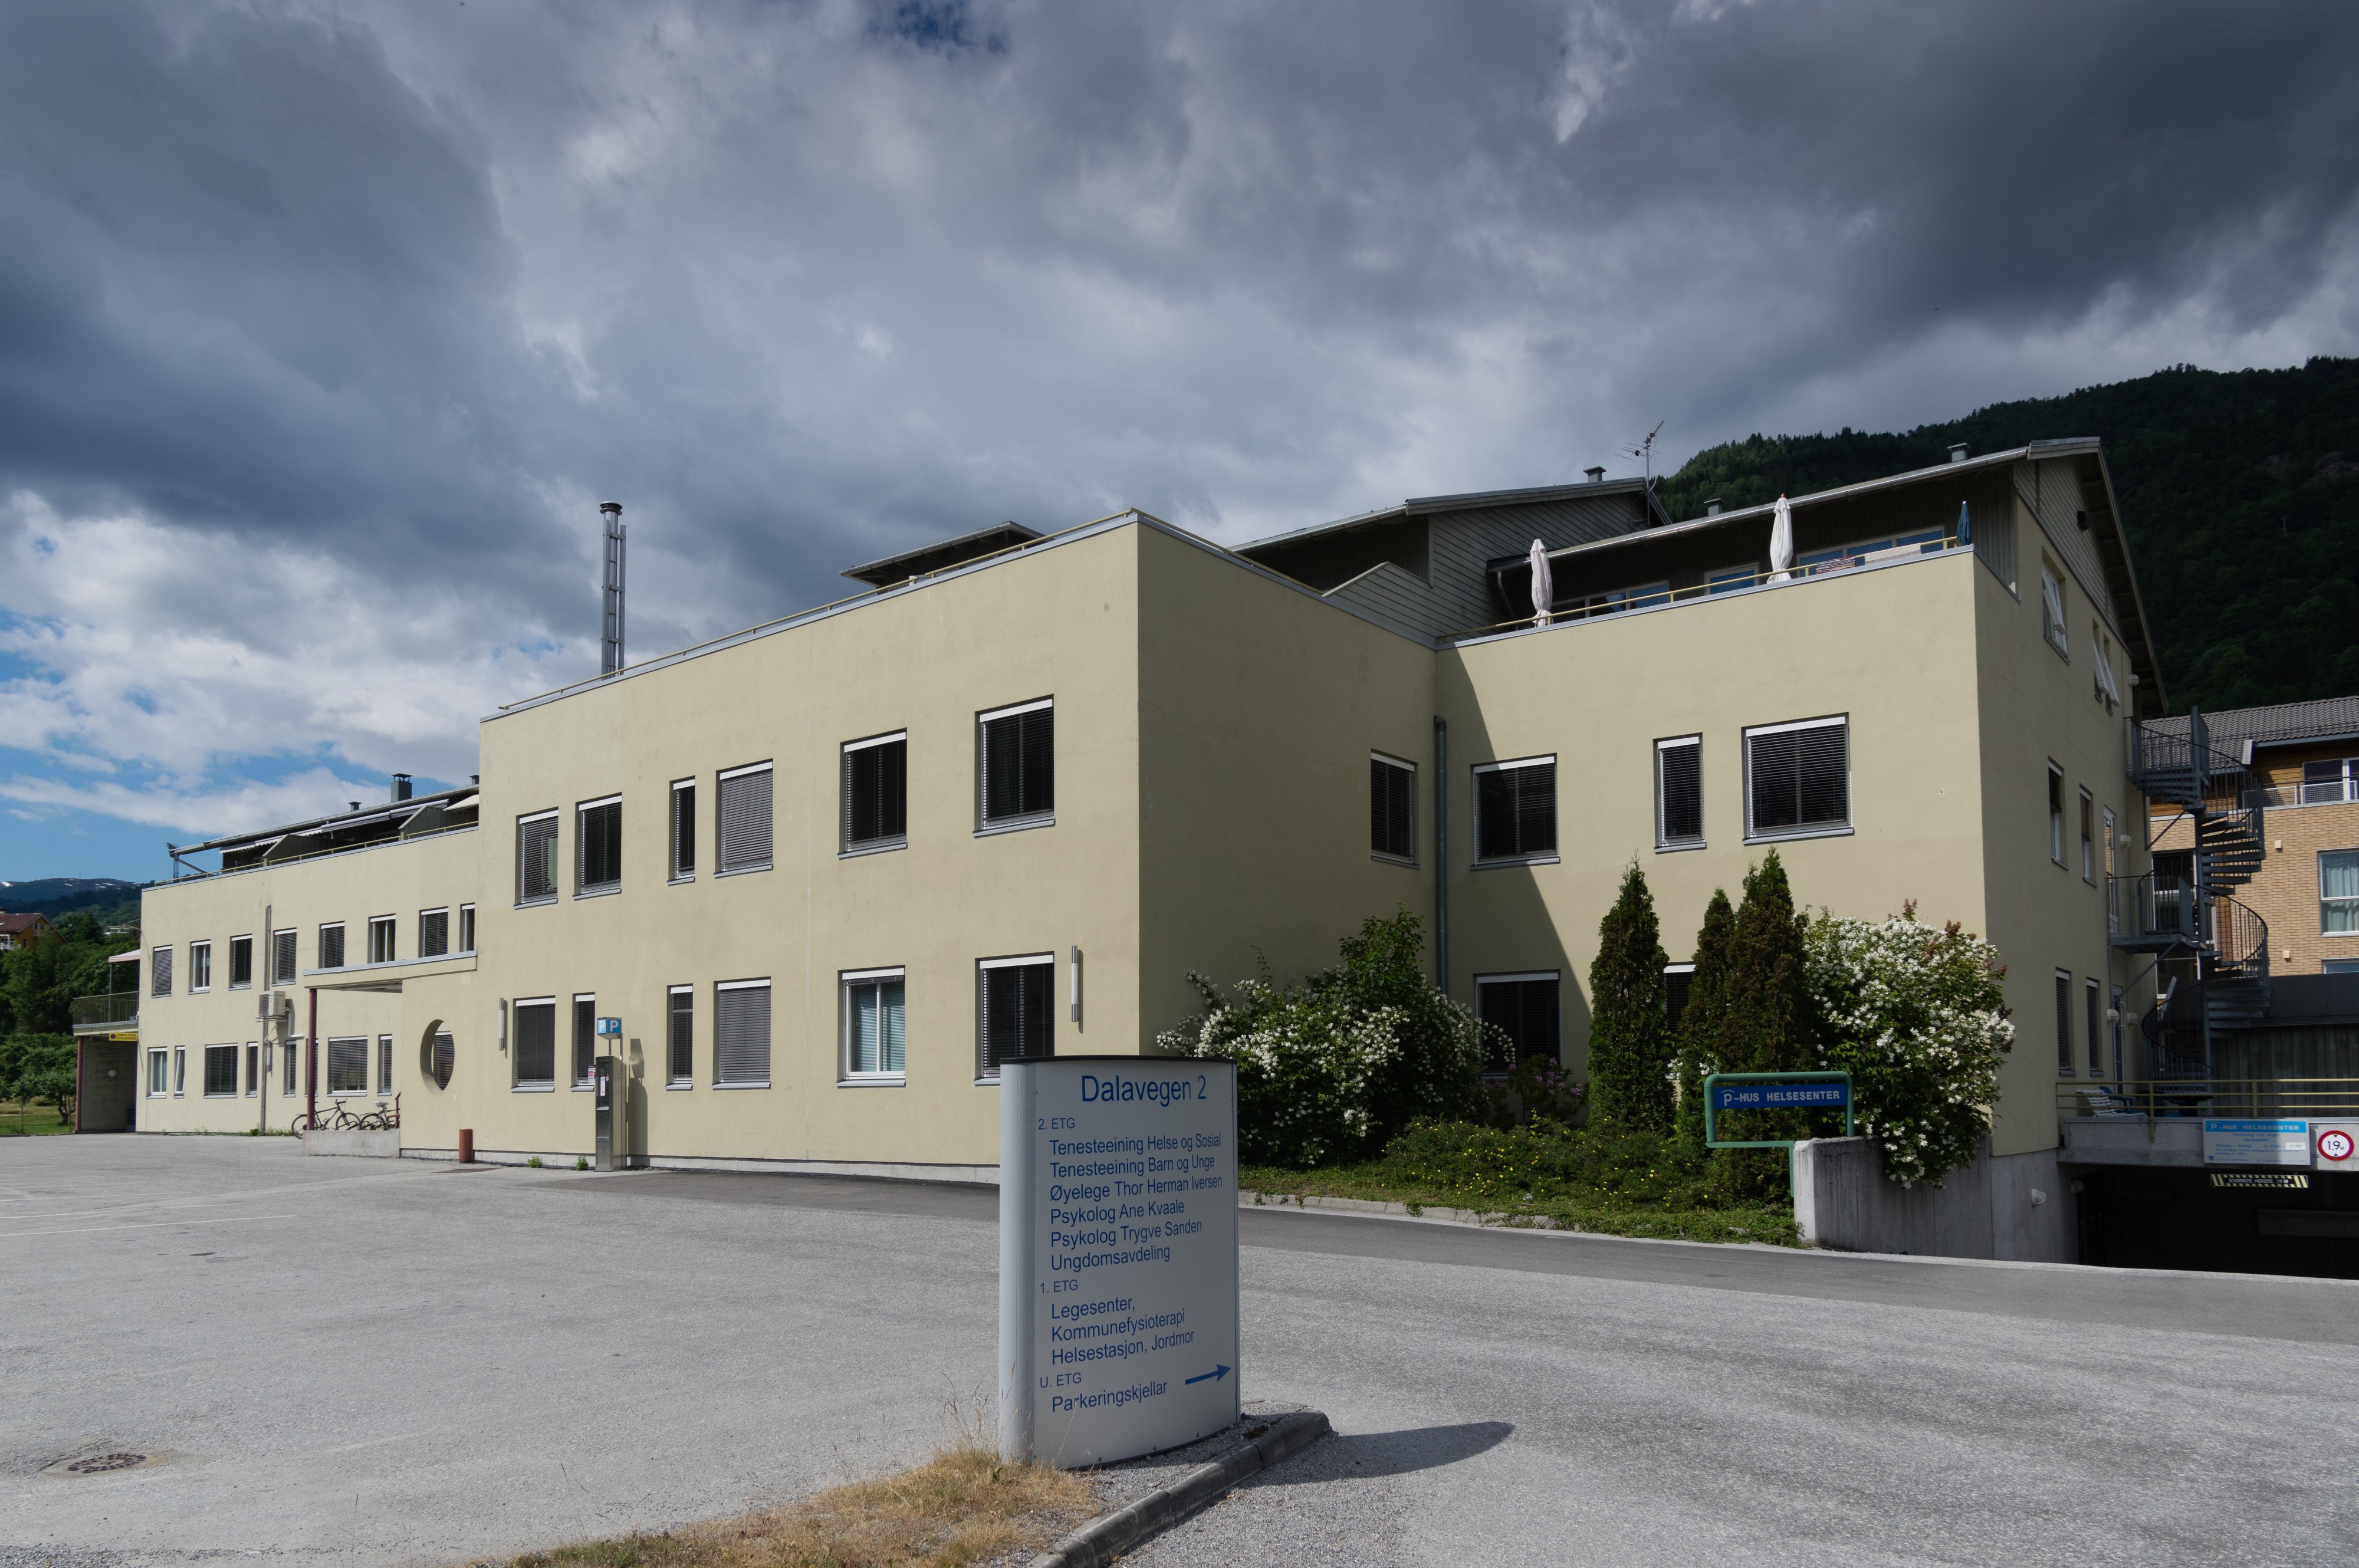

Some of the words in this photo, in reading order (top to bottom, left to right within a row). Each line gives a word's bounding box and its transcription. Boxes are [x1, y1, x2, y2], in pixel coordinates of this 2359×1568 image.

[610, 1020, 619, 1032] P
[1082, 1075, 1191, 1107] Dalavegen
[1197, 1075, 1207, 1100] 2
[1767, 1090, 1839, 1102] HELSESENTER
[1037, 1118, 1048, 1130] 2.
[1052, 1117, 1075, 1130] ETG
[1050, 1137, 1144, 1156] Tenesteeining
[1148, 1135, 1178, 1151] Helse
[1181, 1137, 1192, 1152] og
[1195, 1132, 1221, 1148] Sosial
[1050, 1159, 1144, 1179] Tenesteeining
[1148, 1157, 1174, 1172] Barn
[1177, 1159, 1189, 1173] og
[1192, 1155, 1215, 1171] Unge
[1050, 1184, 1110, 1204] Øyelege
[1114, 1181, 1144, 1196] Thor
[1148, 1178, 1188, 1194] Herman
[1191, 1176, 1223, 1190] Iversen
[1051, 1207, 1115, 1227] Psykolog
[1119, 1204, 1144, 1219] Ane
[1148, 1199, 1184, 1216] Kvaale
[1051, 1231, 1116, 1250] Psykolog
[1121, 1225, 1161, 1244] Trygve
[1165, 1219, 1202, 1235] Sanden
[1052, 1245, 1171, 1273] Ungdomsavdeling
[1040, 1282, 1049, 1294] 1.
[1053, 1279, 1079, 1293] ETG
[1052, 1297, 1135, 1321] Legesenter,
[1052, 1308, 1185, 1342] Kommunefysioterapi
[1052, 1341, 1148, 1365] Helsestasjon,
[1152, 1329, 1194, 1350] Jordmor
[1040, 1376, 1052, 1388] U.
[1056, 1372, 1082, 1386] ETG
[1052, 1381, 1167, 1413] Parkeringskjellar
